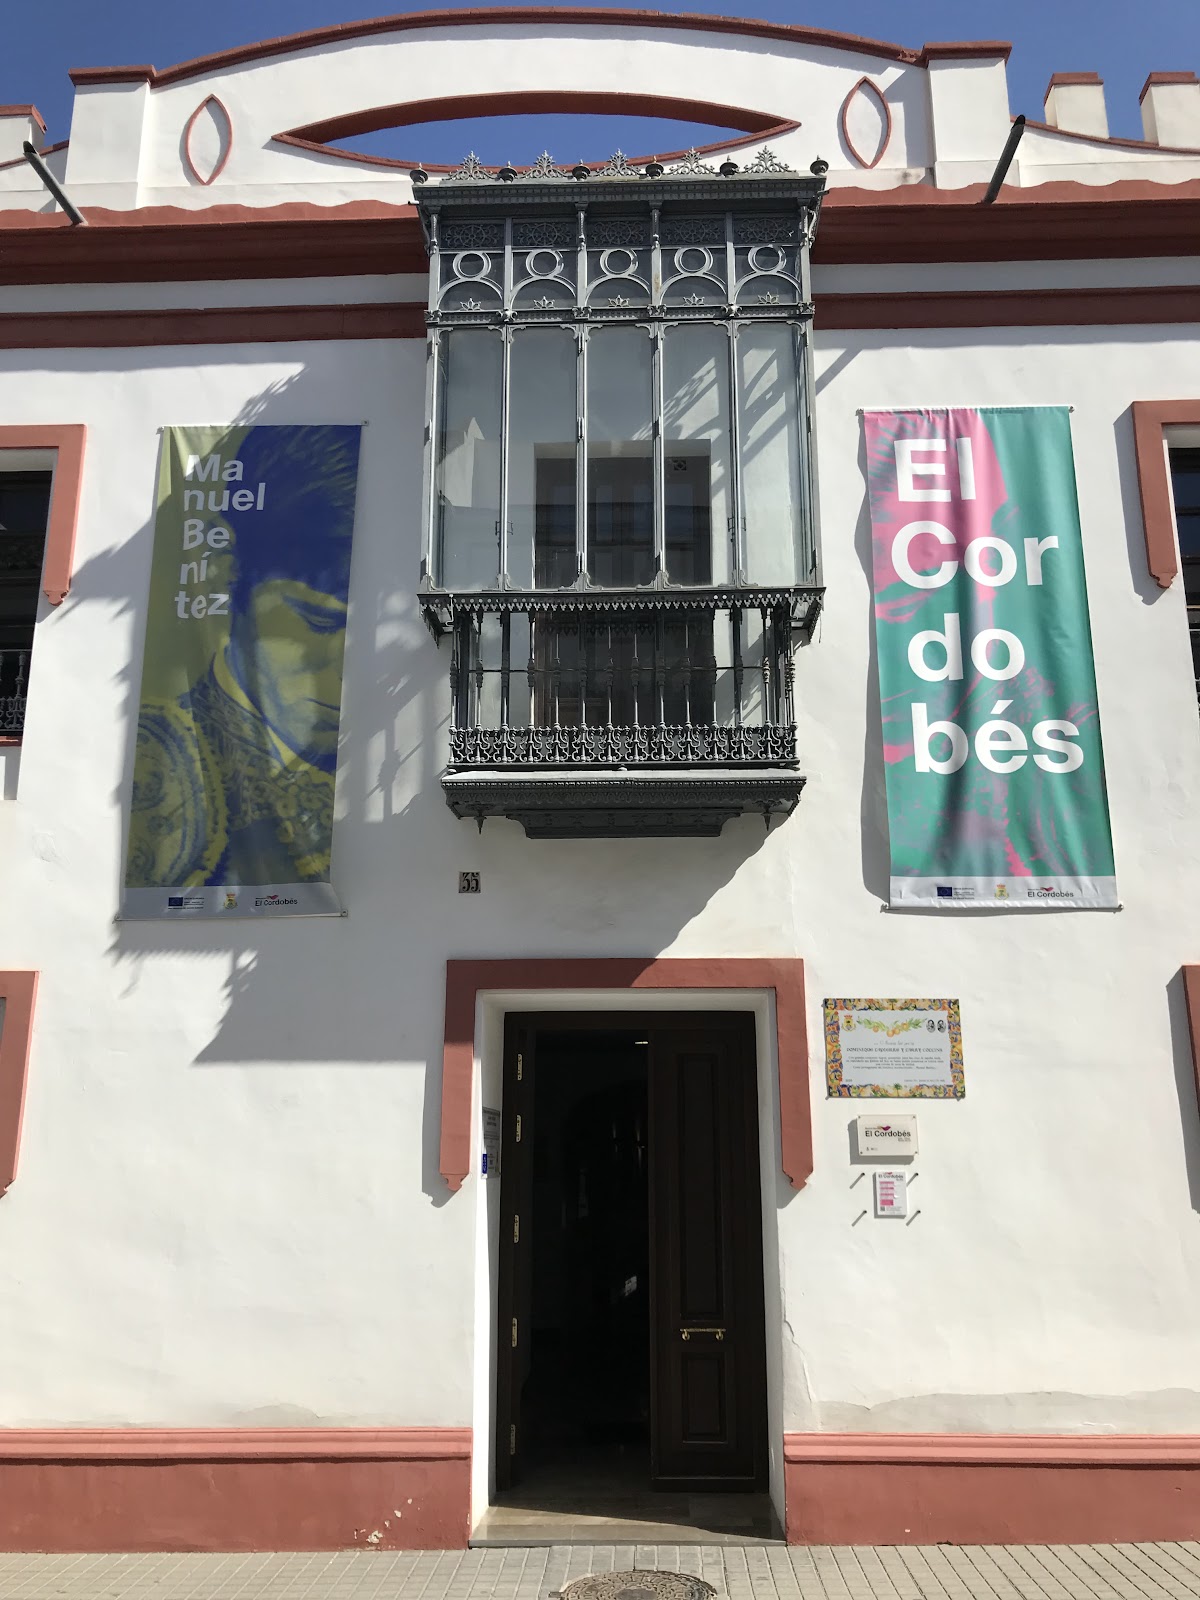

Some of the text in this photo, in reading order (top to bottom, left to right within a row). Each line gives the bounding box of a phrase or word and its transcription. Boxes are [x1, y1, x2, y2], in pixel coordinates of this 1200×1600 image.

[184, 454, 244, 482] Ma
[894, 437, 977, 502] El
[183, 482, 266, 511] nuel
[183, 518, 230, 550] Be
[179, 552, 212, 585] ní
[891, 520, 1059, 589] Cor
[174, 590, 230, 619] tez
[907, 613, 1026, 682] do
[911, 700, 1084, 775] bés
[462, 872, 479, 892] 35
[1036, 890, 1074, 898] Cordobés
[874, 1129, 911, 1137] Cordobés
